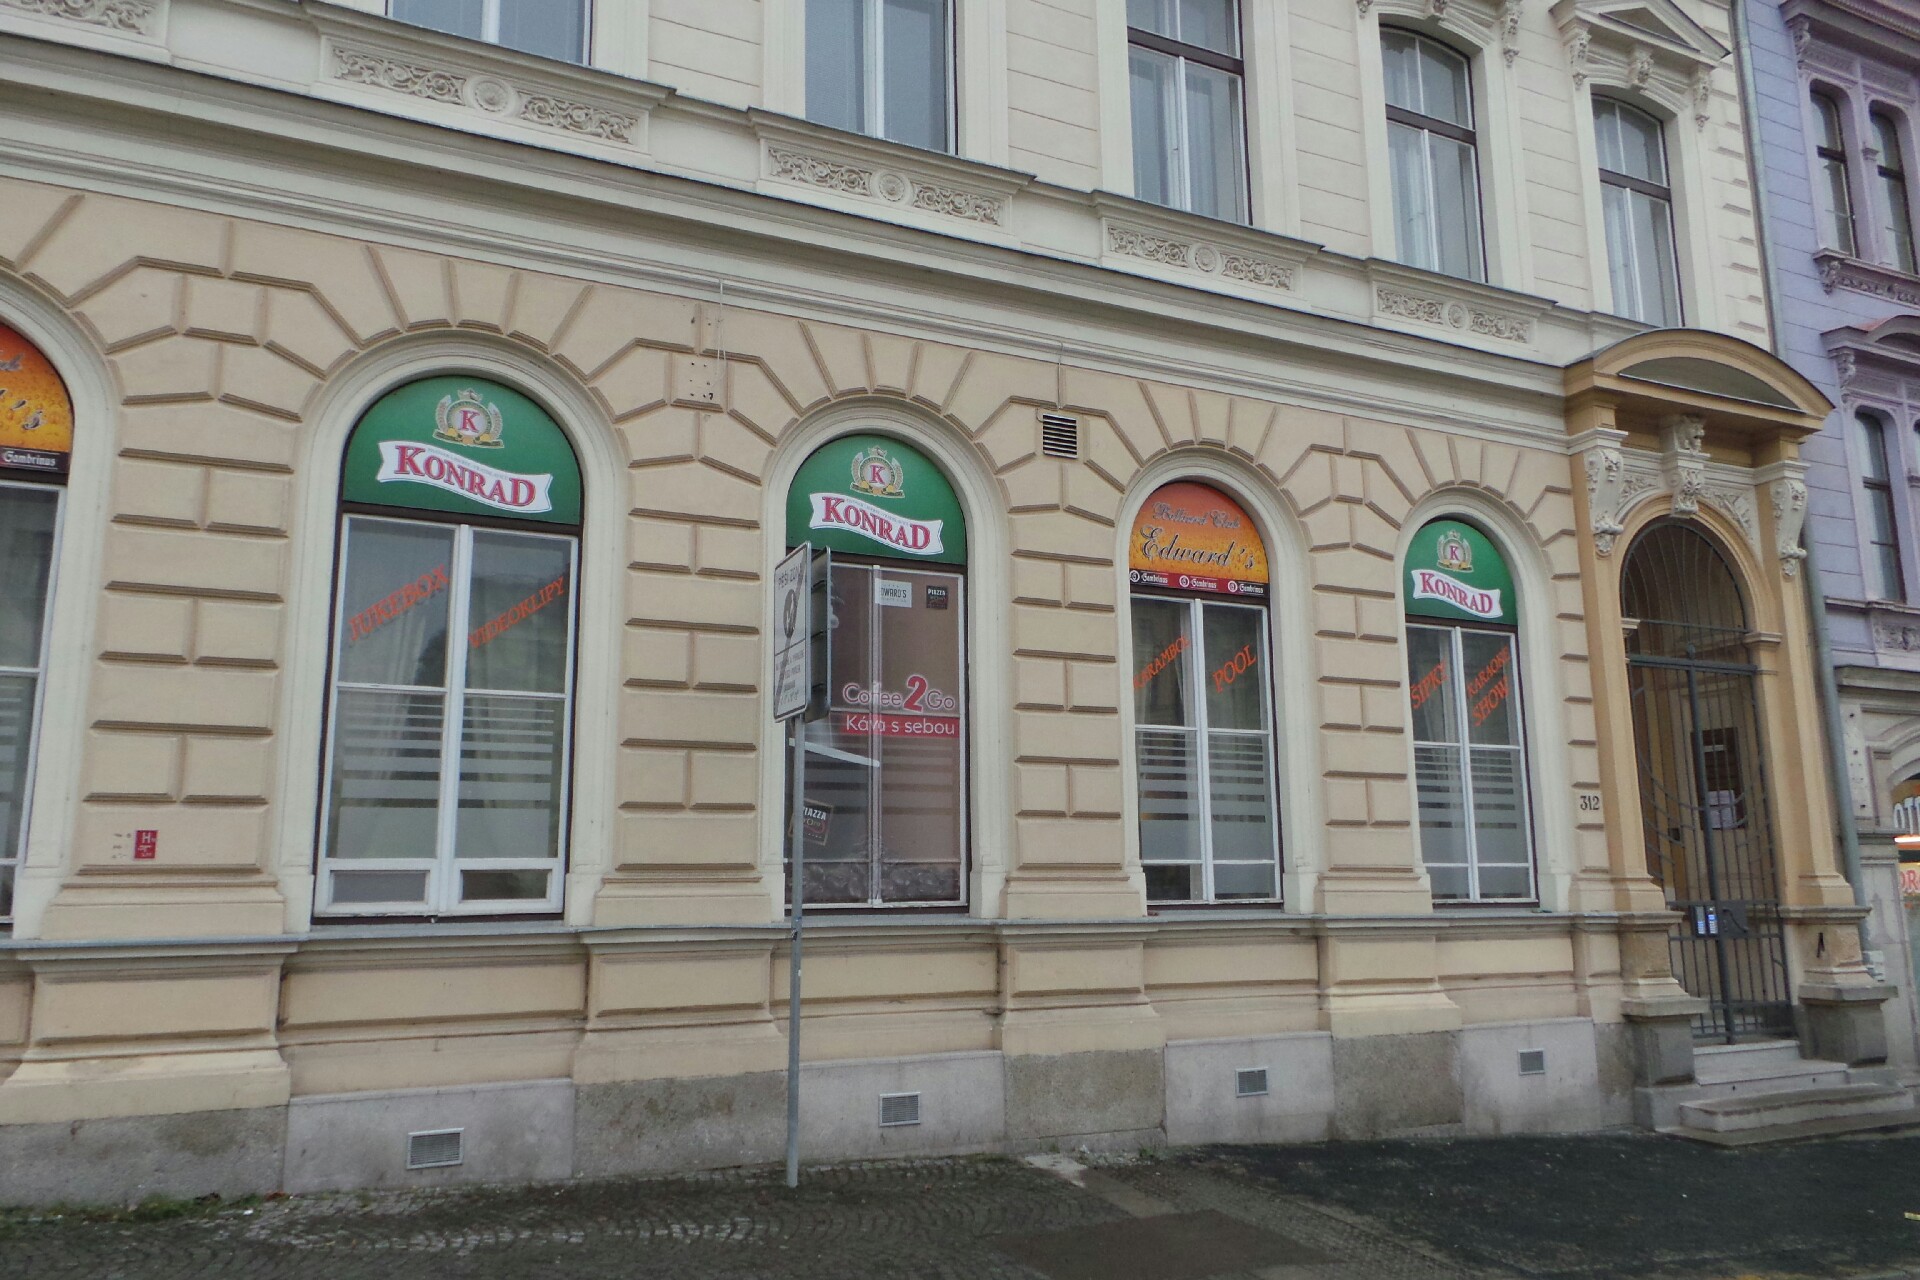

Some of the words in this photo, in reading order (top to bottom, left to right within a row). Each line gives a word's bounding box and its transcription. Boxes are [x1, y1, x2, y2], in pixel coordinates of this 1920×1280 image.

[394, 445, 537, 507] KONRAD
[821, 495, 931, 550] KONRAD
[348, 563, 449, 641] JUKEBOX
[468, 576, 564, 648] VIDEOKLIPY
[1419, 572, 1494, 614] KONRAD
[1132, 632, 1190, 690] KARAMBOL
[1212, 644, 1257, 694] POOL
[846, 714, 886, 732] Káva
[891, 721, 900, 733] s
[904, 717, 955, 735] sebou
[1472, 675, 1508, 727] SHOW
[803, 807, 827, 821] IAZZA
[1580, 795, 1600, 811] 312
